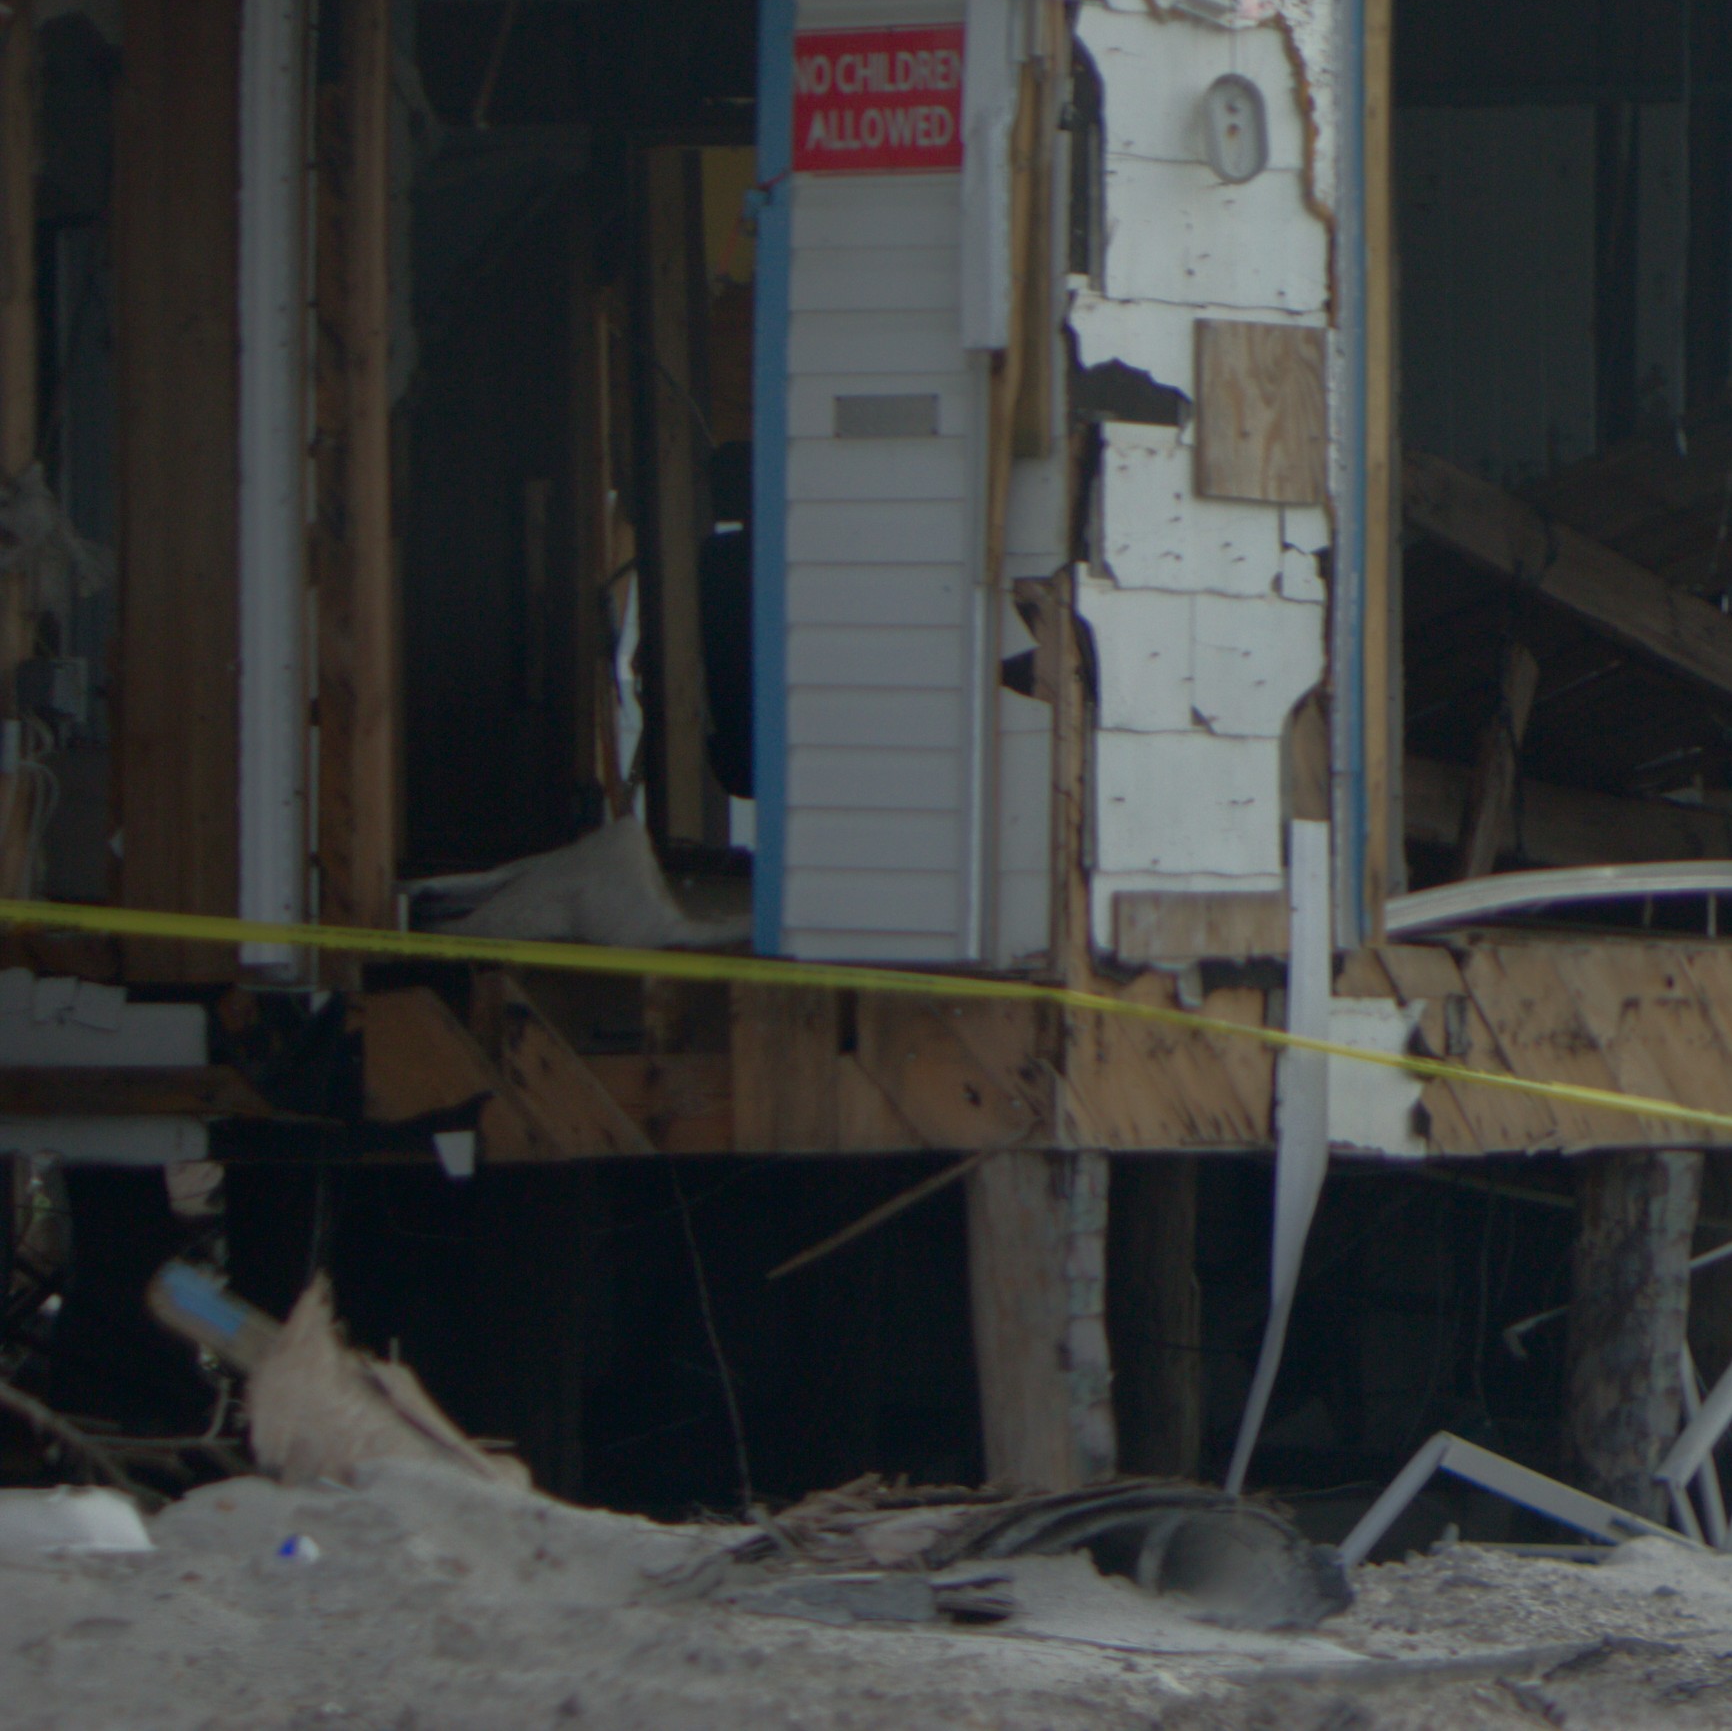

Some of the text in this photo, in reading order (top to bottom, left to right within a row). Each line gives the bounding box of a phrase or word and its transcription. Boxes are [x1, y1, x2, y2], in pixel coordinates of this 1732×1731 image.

[793, 49, 961, 94] NO CHILDREN
[805, 105, 954, 150] ALLOWED
